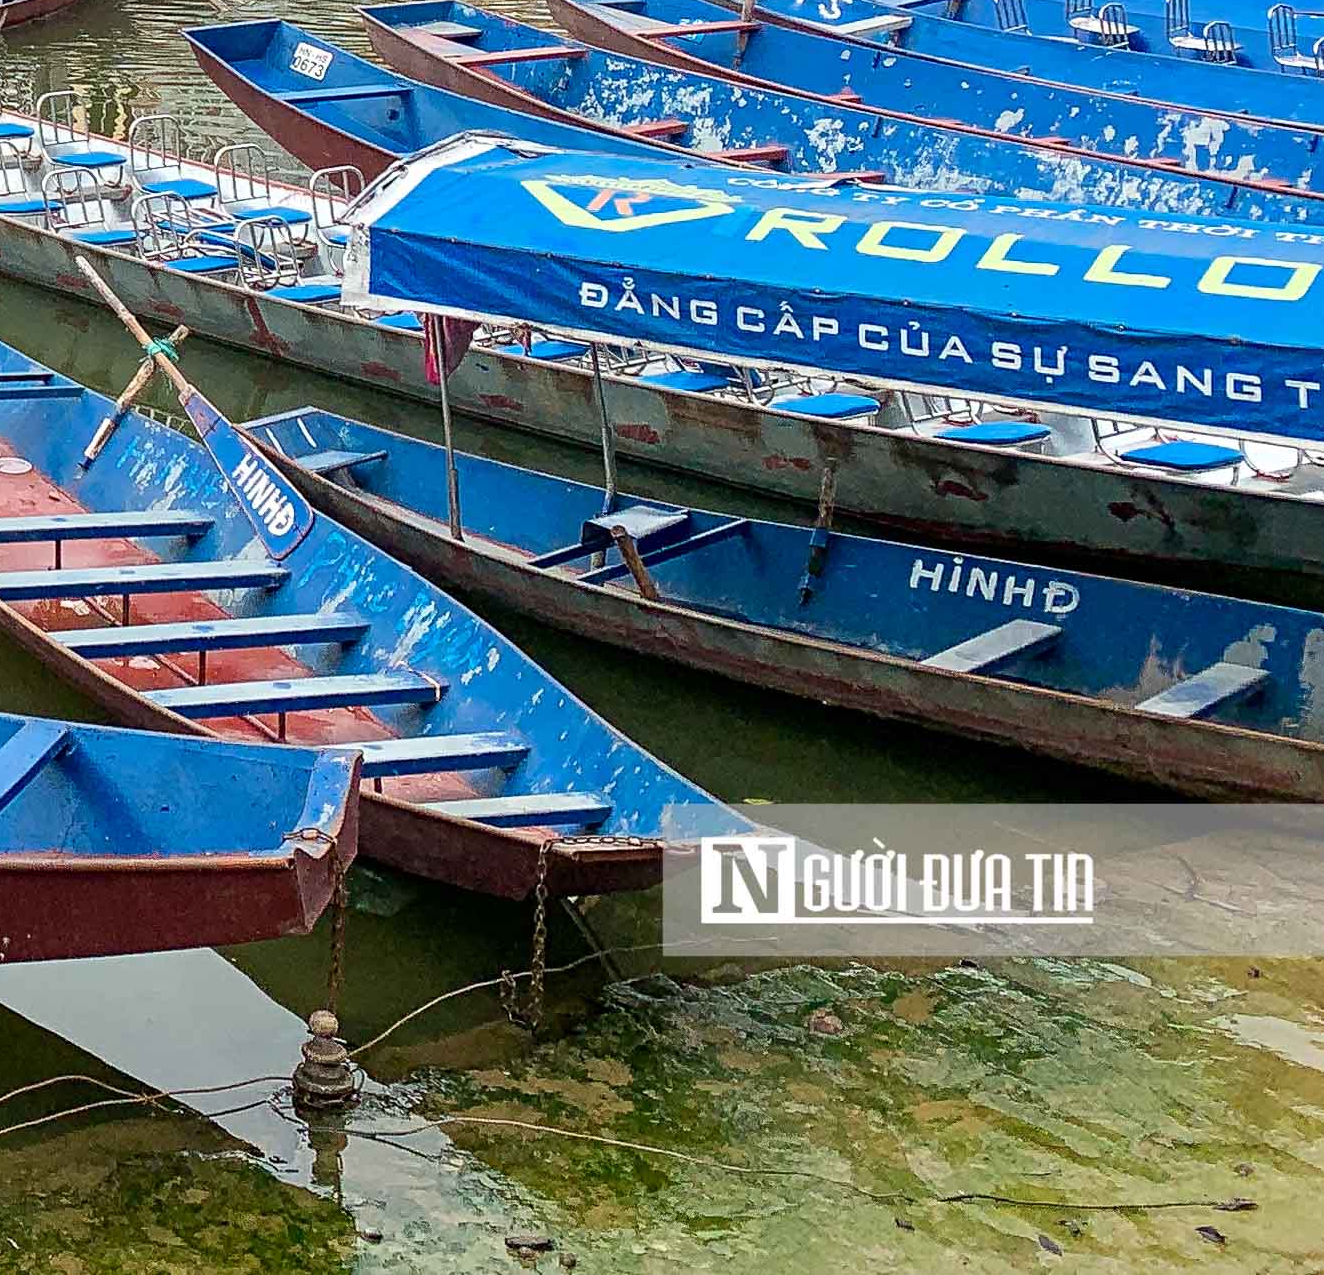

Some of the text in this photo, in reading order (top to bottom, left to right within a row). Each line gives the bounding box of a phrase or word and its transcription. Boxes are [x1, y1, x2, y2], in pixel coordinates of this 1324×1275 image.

[293, 55, 324, 77] 0673
[579, 276, 718, 326] ĐẲNG
[736, 296, 840, 343] CẤP
[857, 316, 974, 366] CỦA
[991, 341, 1067, 386] SỰ
[1088, 356, 1264, 402] SANG
